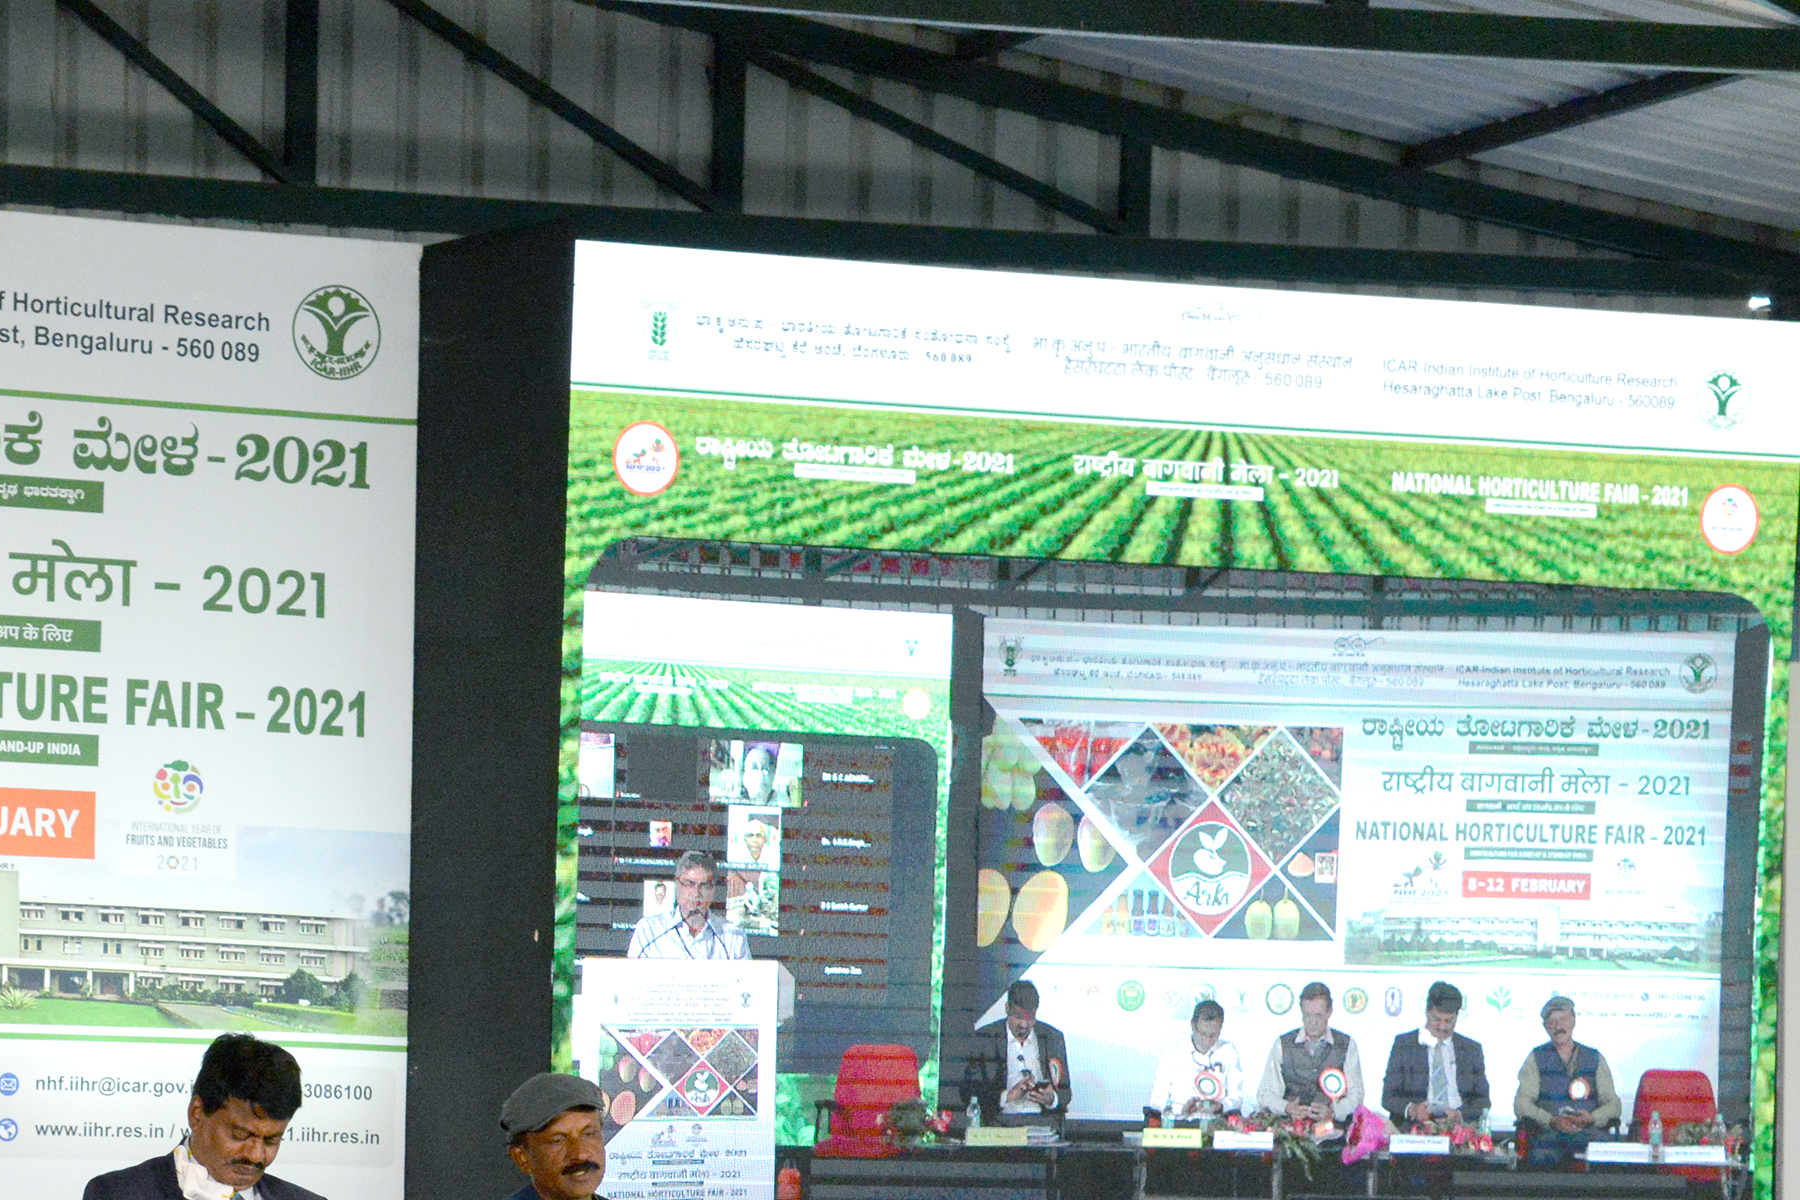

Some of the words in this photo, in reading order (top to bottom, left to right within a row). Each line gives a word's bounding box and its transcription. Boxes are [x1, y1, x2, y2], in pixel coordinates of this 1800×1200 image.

[13, 292, 154, 323] Horticultural
[164, 304, 269, 331] Research
[35, 326, 152, 355] Bengaluru
[310, 358, 363, 377] ICAR-IIHR
[1383, 358, 1463, 375] ICAR-Indian
[1468, 362, 1519, 379] Institute
[1523, 366, 1536, 380] of
[1617, 372, 1678, 389] Research
[1072, 451, 1136, 479] राष्ट्रीय
[1143, 457, 1223, 482] बागवानी
[1230, 459, 1274, 484] मेला
[1295, 468, 1339, 488] 2021
[1392, 472, 1475, 495] NATIONAL
[1478, 477, 1600, 502] HORTICULTURE
[1604, 483, 1639, 503] FAIR
[1652, 485, 1688, 507] 2021
[9, 539, 137, 606] मेला
[203, 565, 325, 618] 2021
[126, 679, 225, 730] FAIR
[267, 686, 365, 738] 2021
[47, 742, 81, 756] INDIA
[126, 834, 155, 846] FRUITS
[157, 836, 174, 847] AND
[176, 836, 228, 849] VEGETABLES
[1356, 821, 1448, 842] NATIONAL
[1455, 822, 1598, 844] HORTICULTURE
[1605, 824, 1645, 845] FAIR
[1663, 825, 1706, 845] 2021
[1511, 877, 1587, 893] FEBRUARY
[35, 1122, 165, 1139] www.iihr.res.in
